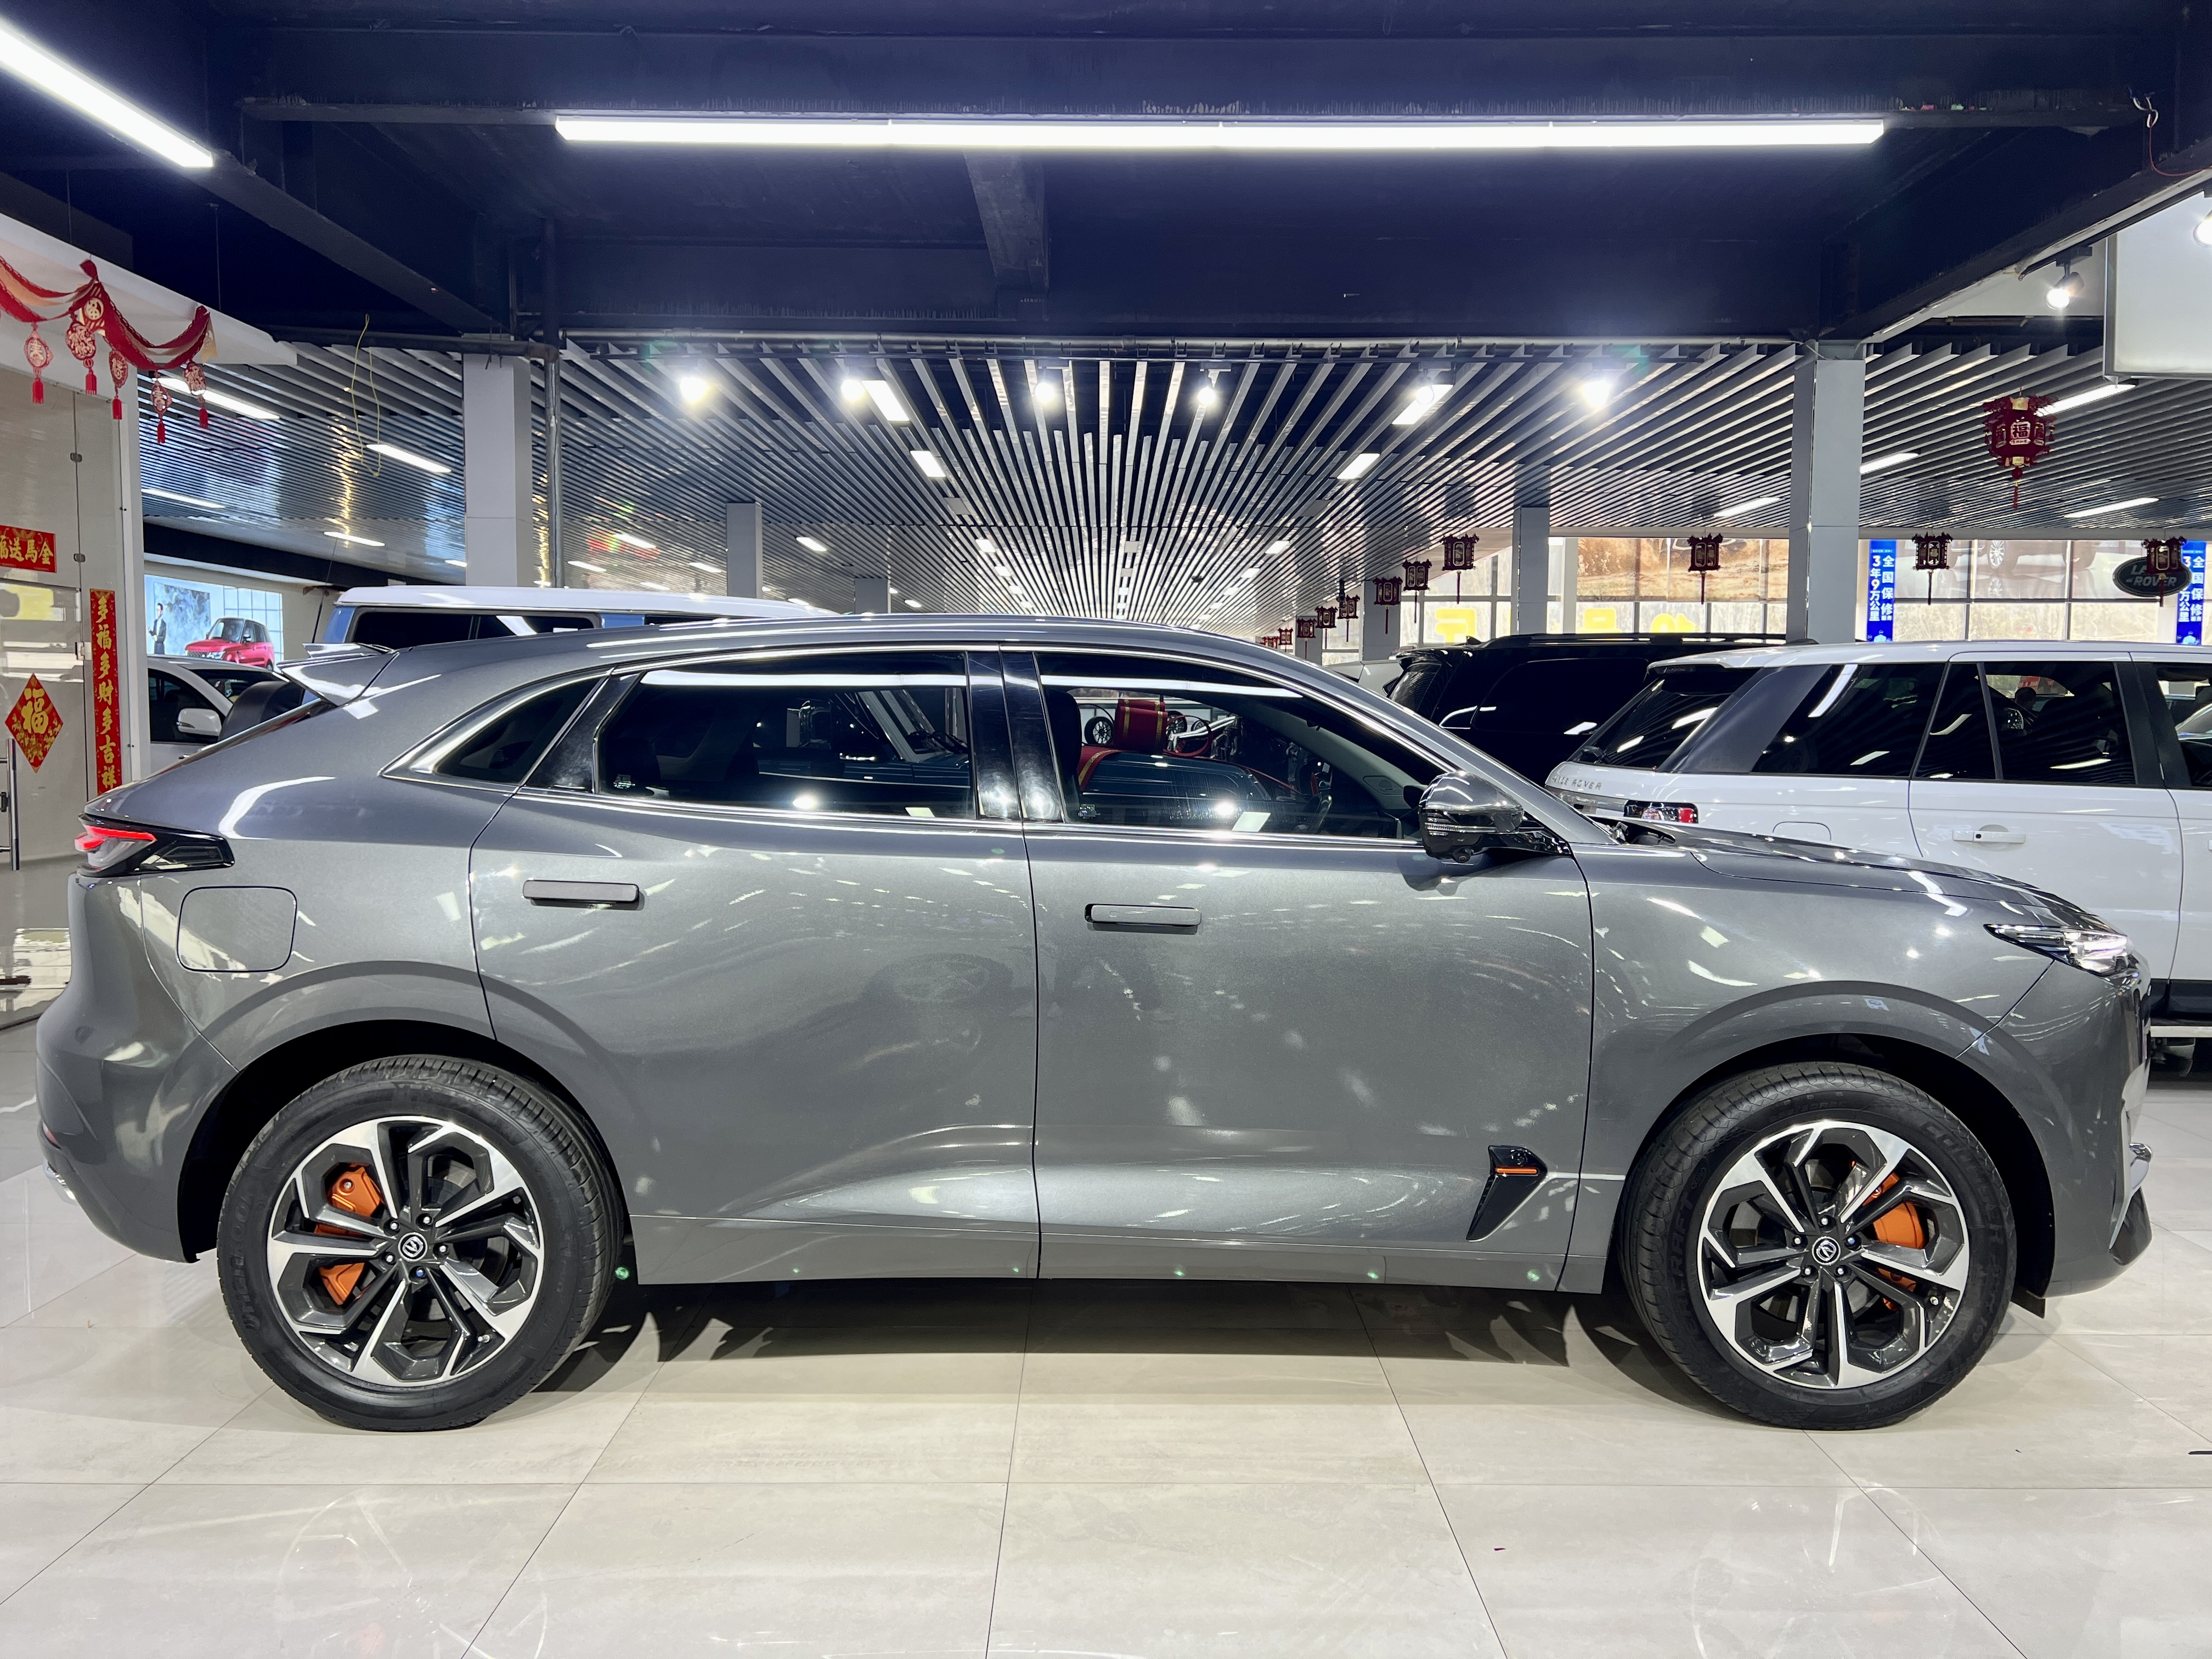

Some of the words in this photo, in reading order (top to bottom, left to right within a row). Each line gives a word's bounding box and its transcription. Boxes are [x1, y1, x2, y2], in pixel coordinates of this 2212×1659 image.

[2012, 424, 2029, 438] 福
[1869, 555, 1881, 622] 3年9万公里
[2179, 556, 2192, 622] 3万公里
[21, 687, 49, 735] 福
